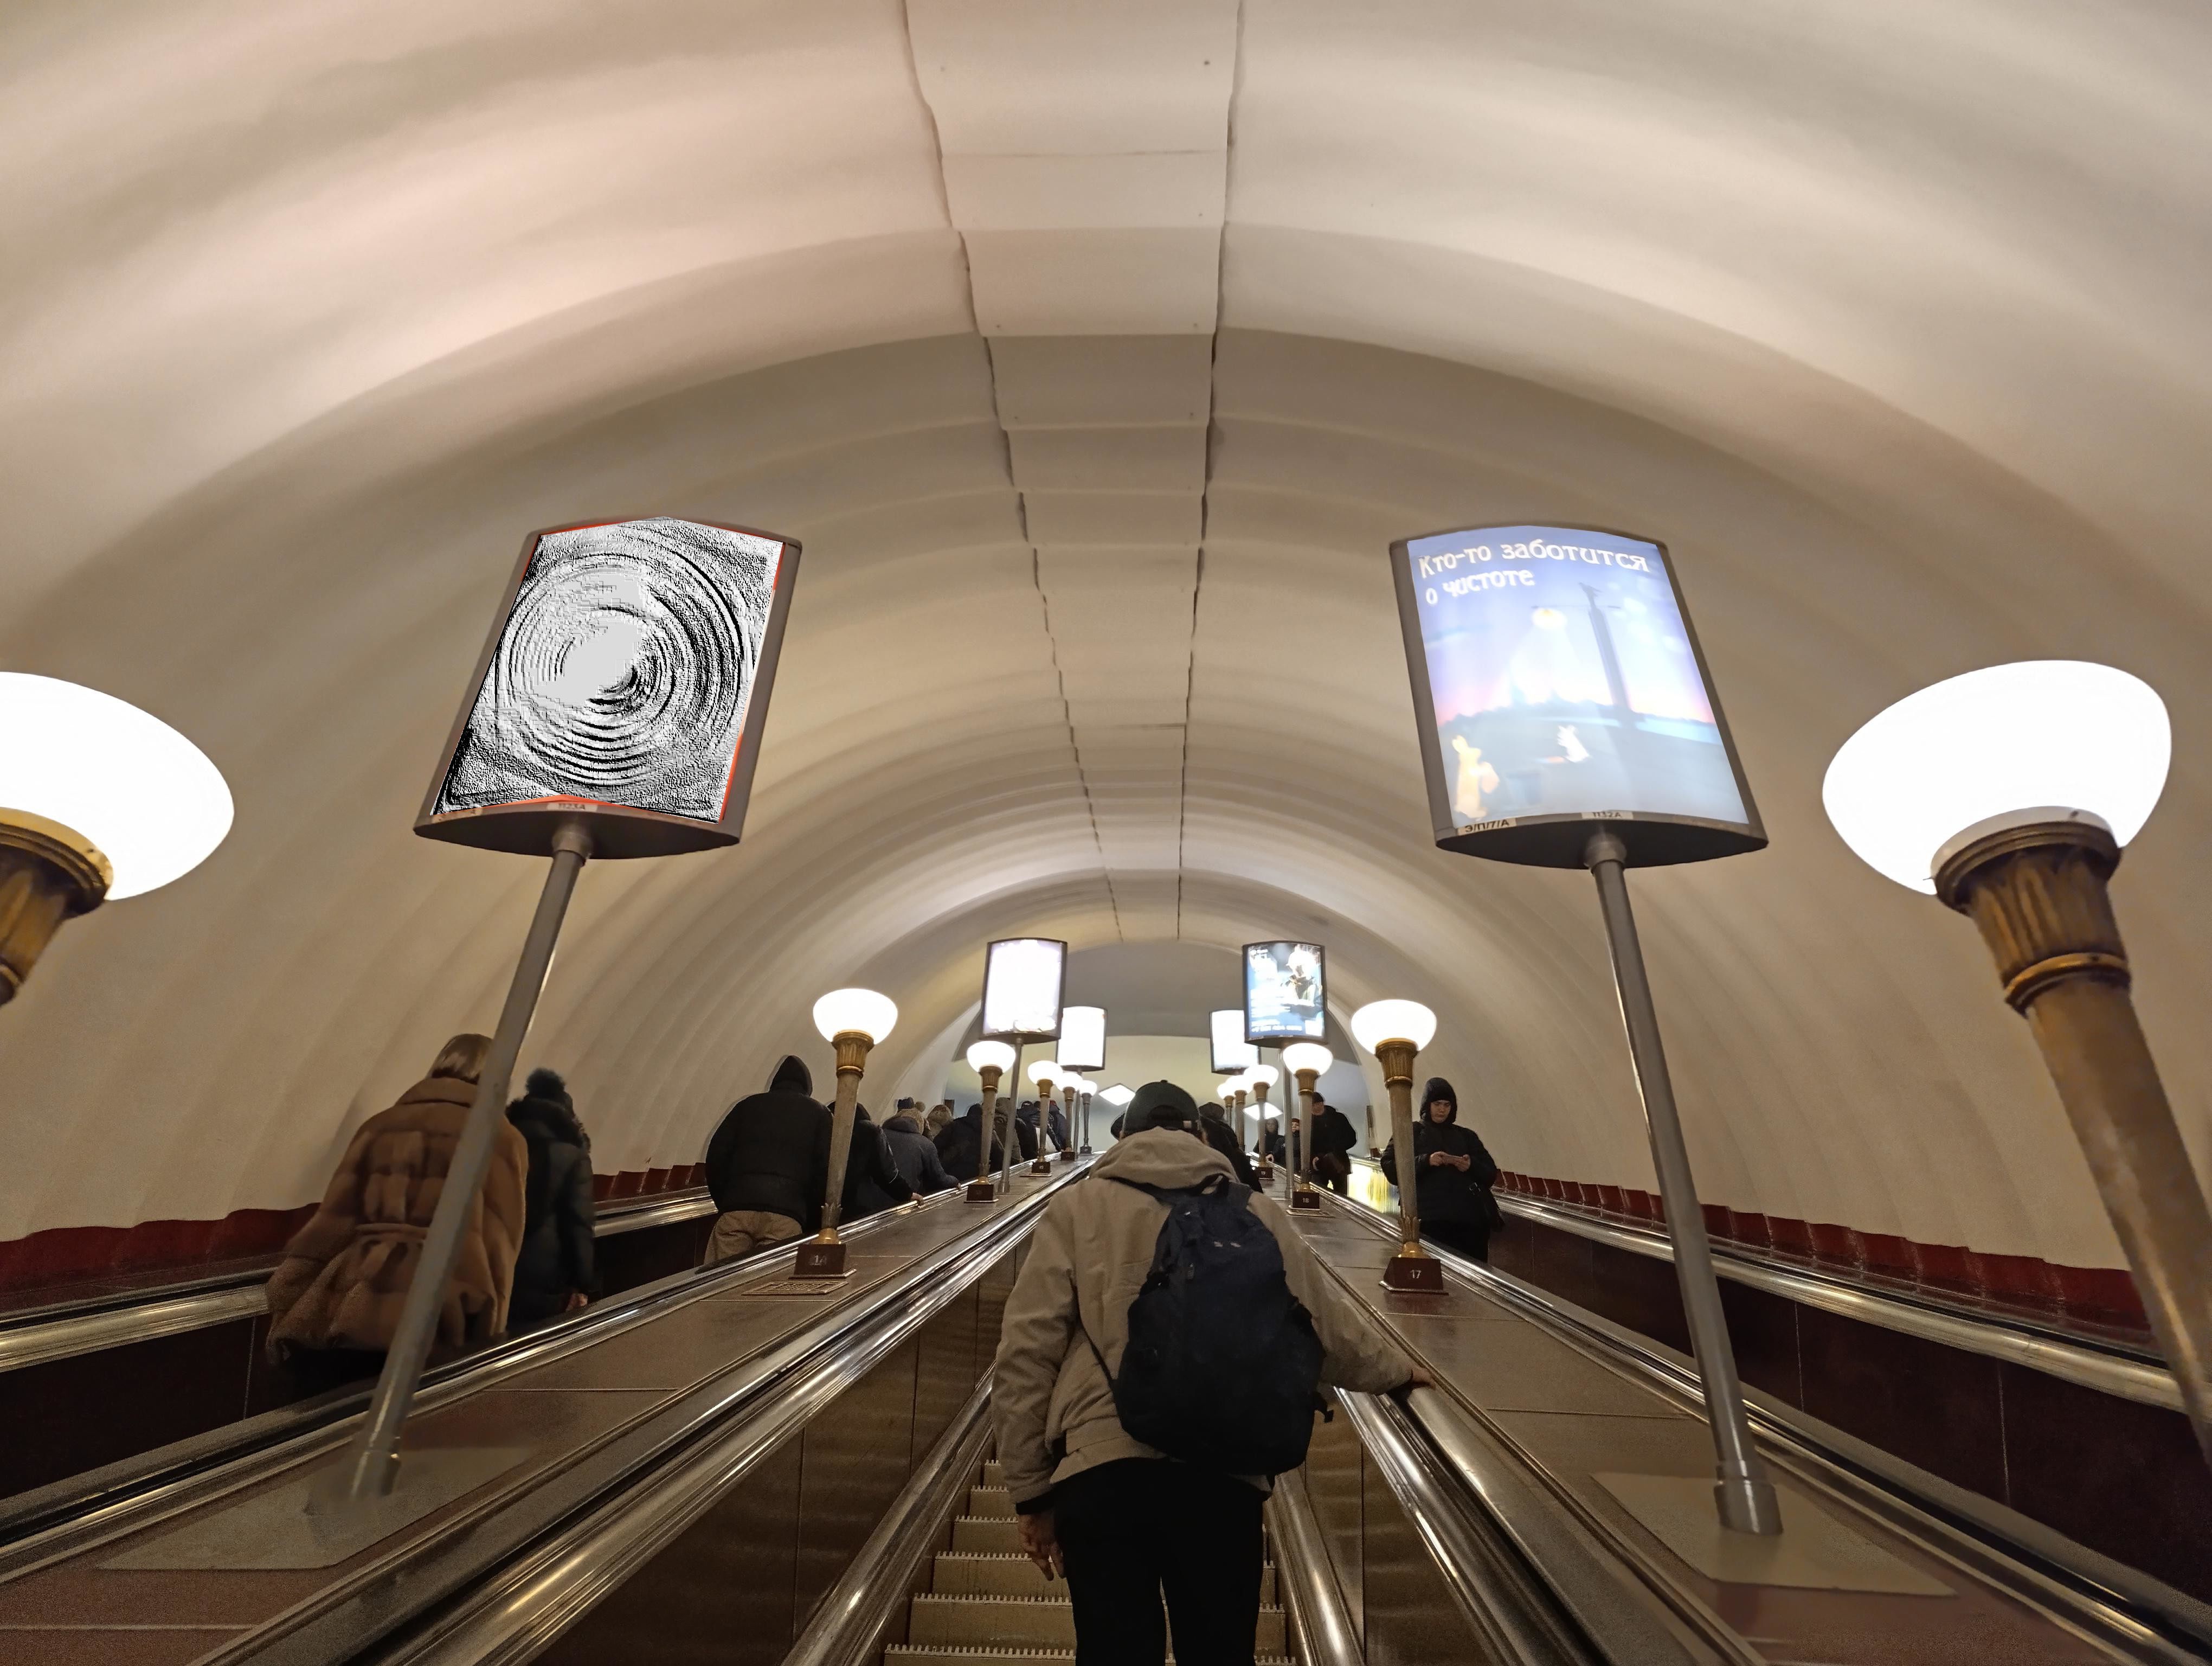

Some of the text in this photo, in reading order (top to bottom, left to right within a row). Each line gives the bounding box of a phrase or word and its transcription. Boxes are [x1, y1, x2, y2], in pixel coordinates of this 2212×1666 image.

[1418, 539, 1650, 579] Кто-то заботится
[1425, 569, 1535, 605] о чистоте
[1410, 1270, 1421, 1279] 17
